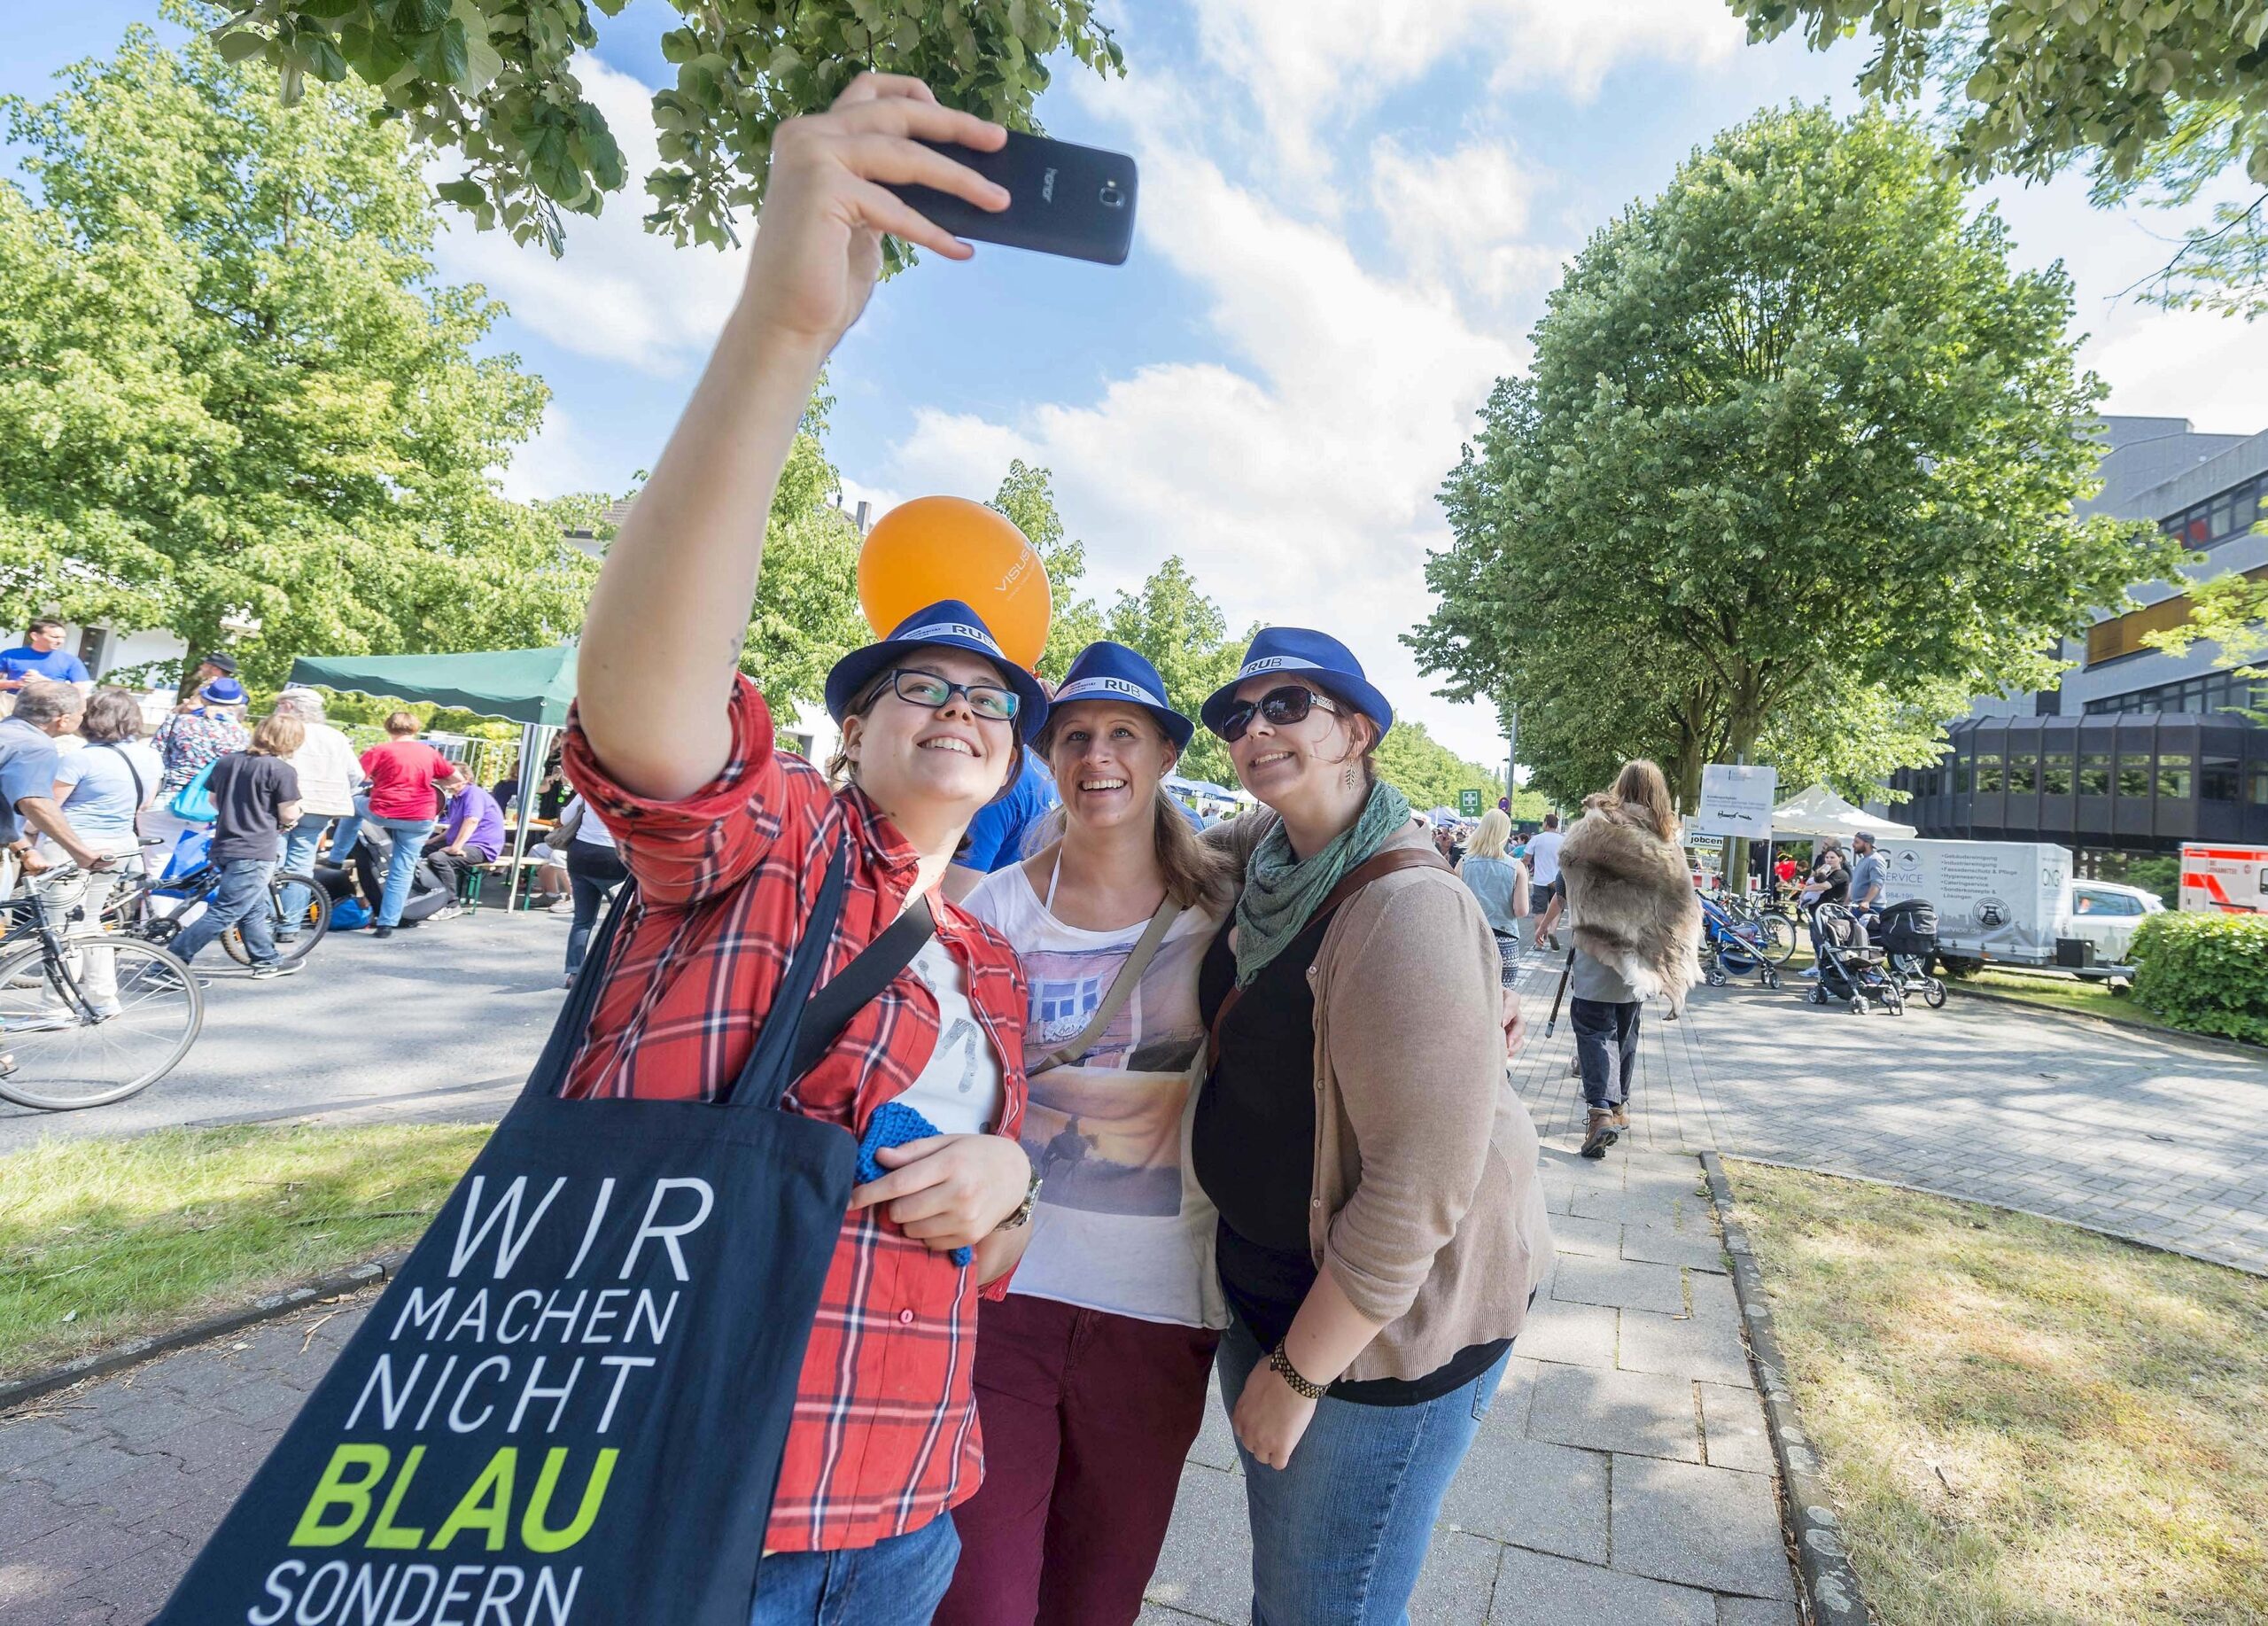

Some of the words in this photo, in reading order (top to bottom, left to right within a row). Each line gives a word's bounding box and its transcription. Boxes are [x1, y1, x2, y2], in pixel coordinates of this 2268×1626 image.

[952, 625, 993, 645] RUB
[1105, 679, 1141, 697] RUB
[1247, 657, 1282, 673] RUB
[1885, 873, 1923, 883] ERVICE
[447, 1175, 715, 1282] WIR
[390, 1287, 680, 1345] MACHEN
[345, 1354, 656, 1434] NICHT
[288, 1443, 620, 1553] BLAU
[247, 1559, 583, 1626] SONDERN
